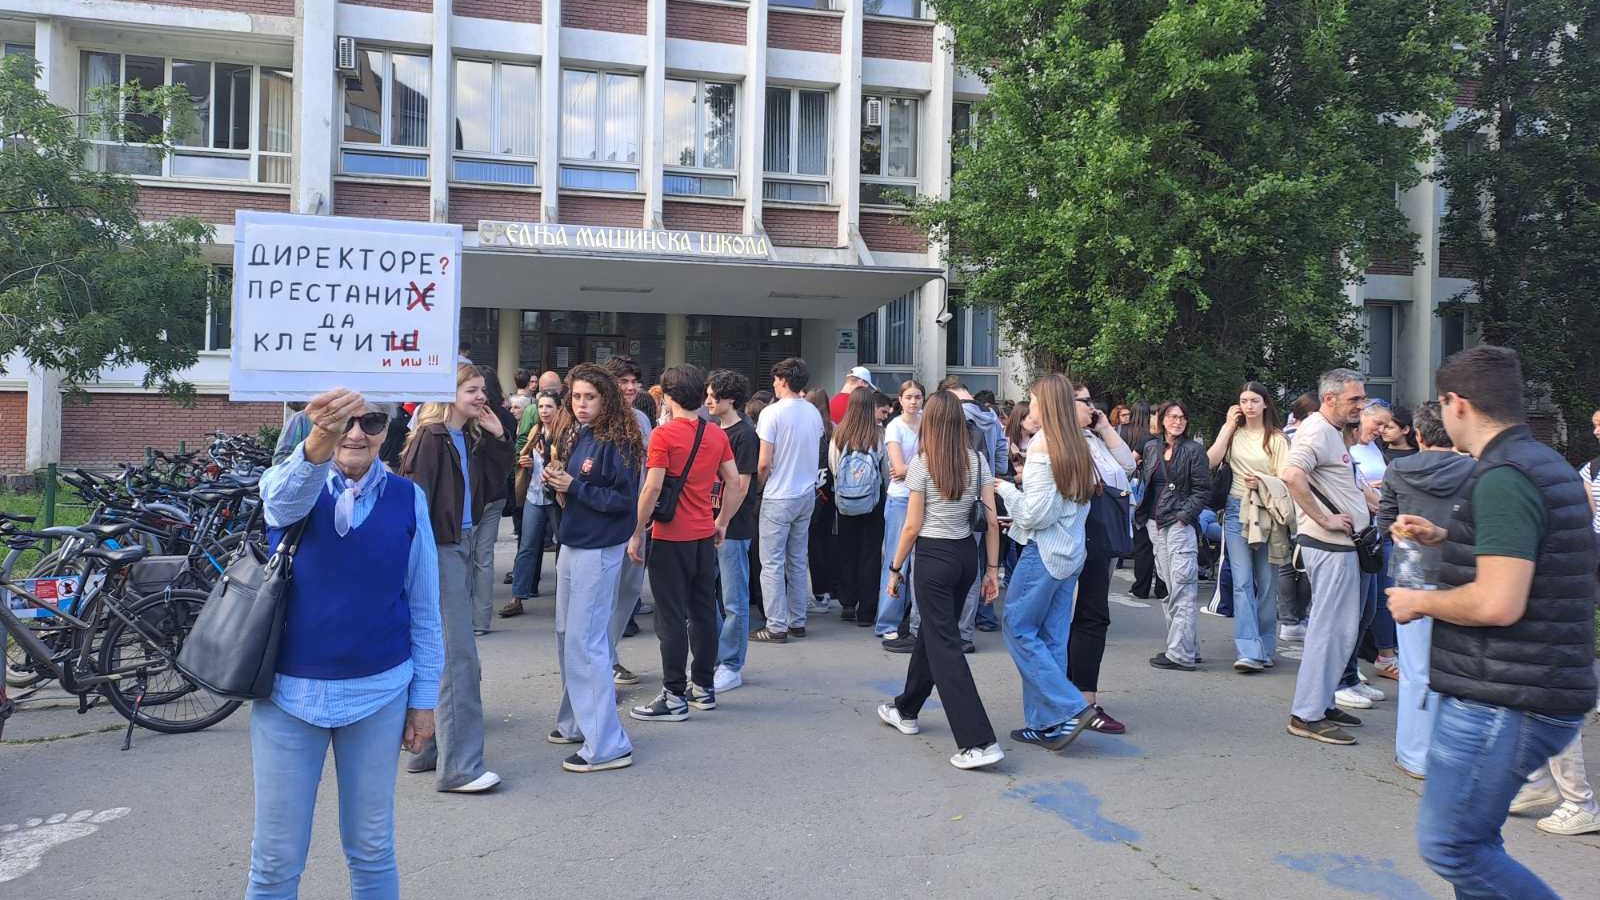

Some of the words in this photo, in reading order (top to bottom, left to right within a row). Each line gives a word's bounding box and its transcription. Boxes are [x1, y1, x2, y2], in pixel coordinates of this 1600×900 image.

[576, 228, 692, 251] МАШИНСКА
[700, 232, 768, 256] ШКОЛА
[318, 313, 354, 329] ДА
